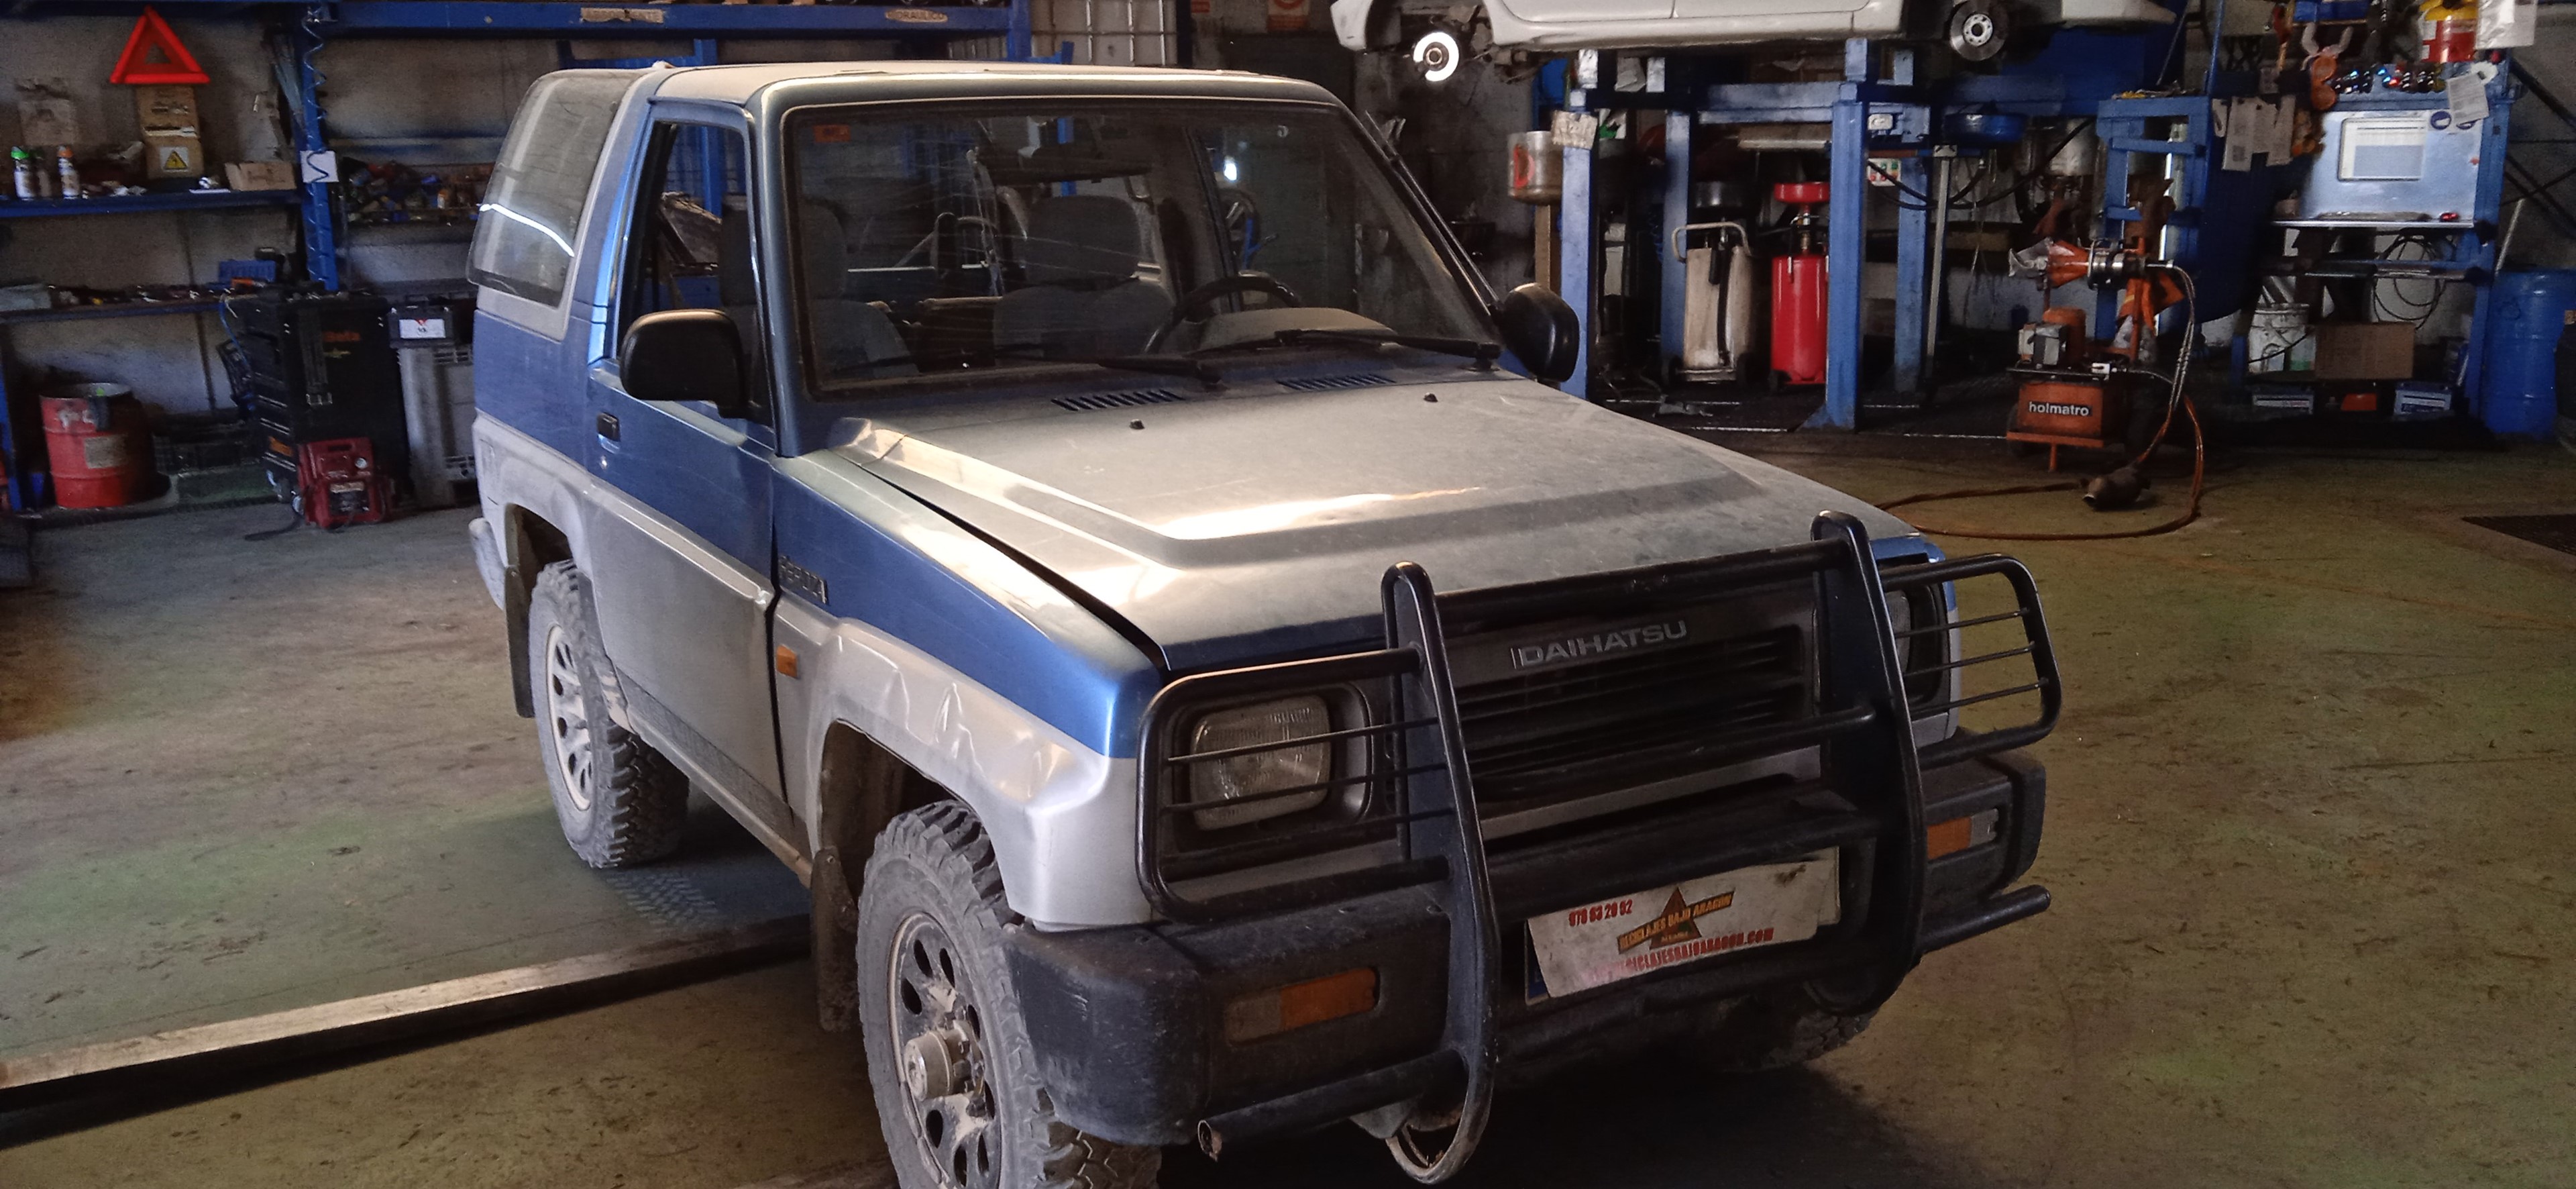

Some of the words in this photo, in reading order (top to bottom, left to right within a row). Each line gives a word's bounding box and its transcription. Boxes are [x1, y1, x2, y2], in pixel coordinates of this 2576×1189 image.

[2029, 402, 2088, 417] holmatro
[1511, 621, 1687, 669] DAIHATSU
[1668, 909, 1692, 928] BAJO
